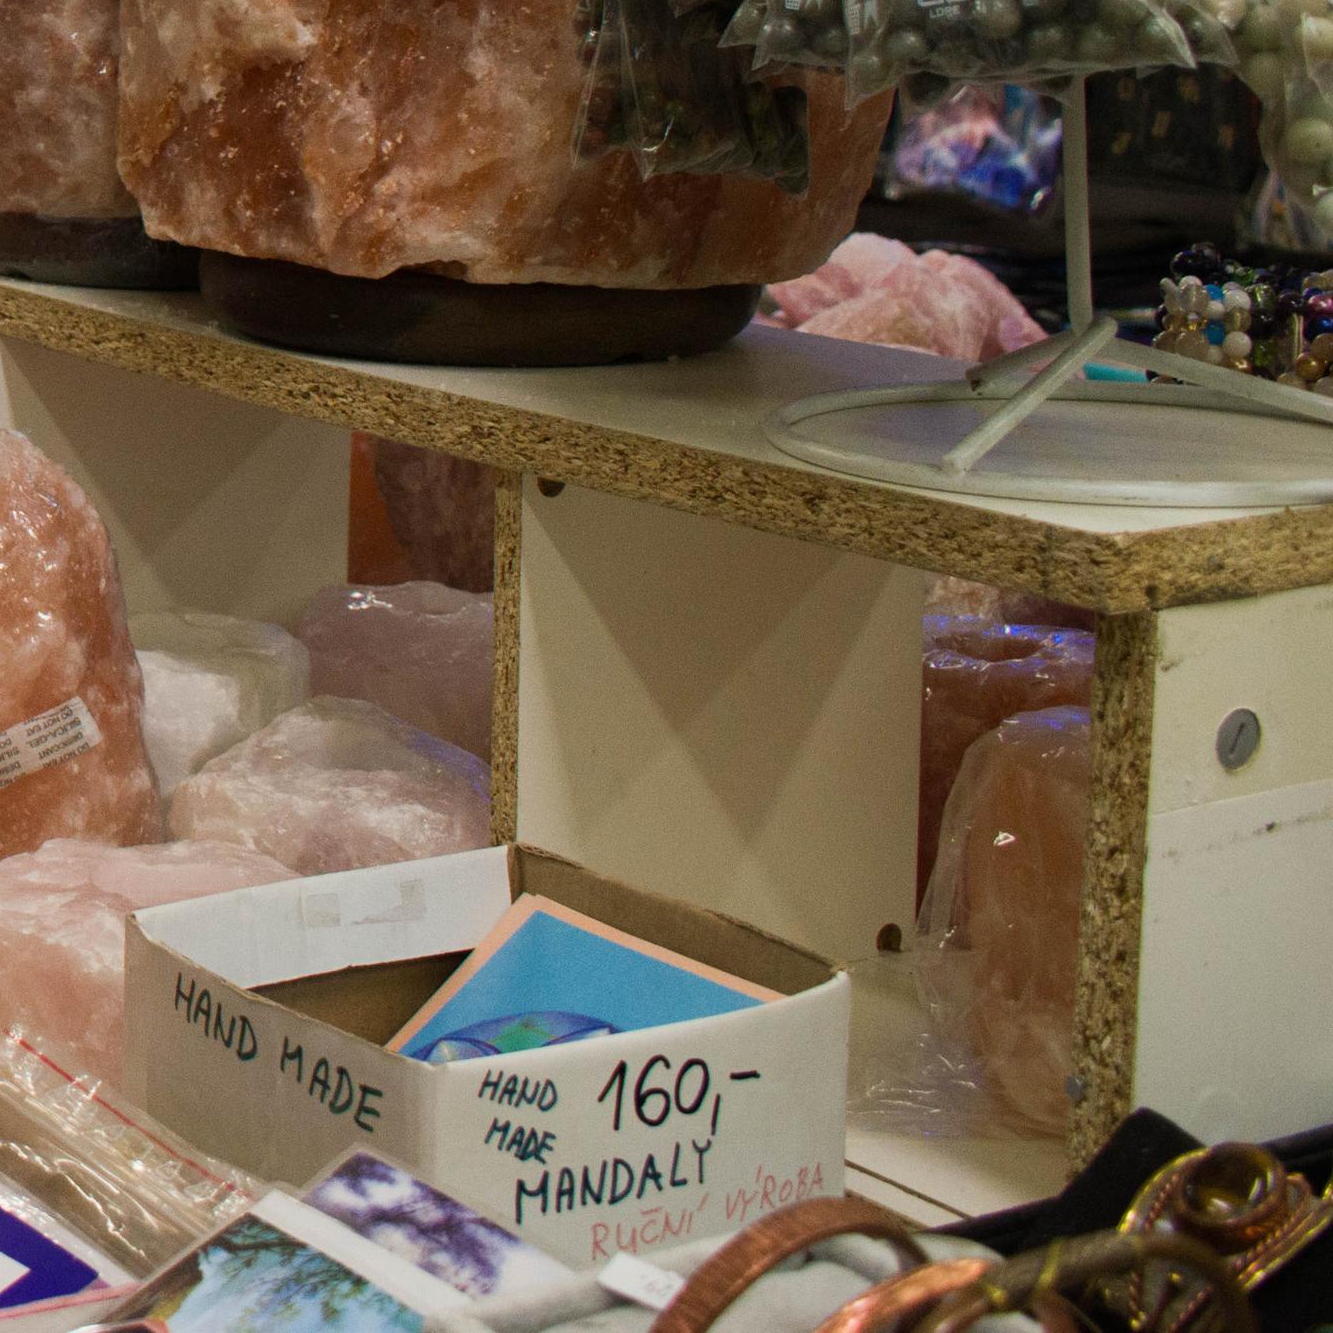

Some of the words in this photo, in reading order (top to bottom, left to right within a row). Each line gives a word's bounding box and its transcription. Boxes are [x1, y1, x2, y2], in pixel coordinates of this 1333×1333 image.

[174, 971, 259, 1062] HAND
[279, 1035, 384, 1133] MADE
[477, 1068, 558, 1112] HAND
[484, 1116, 557, 1165] MADE
[514, 1138, 712, 1225] MANDALY
[590, 1191, 710, 1262] RUČNÍ
[724, 1162, 825, 1222] VÝROBA
